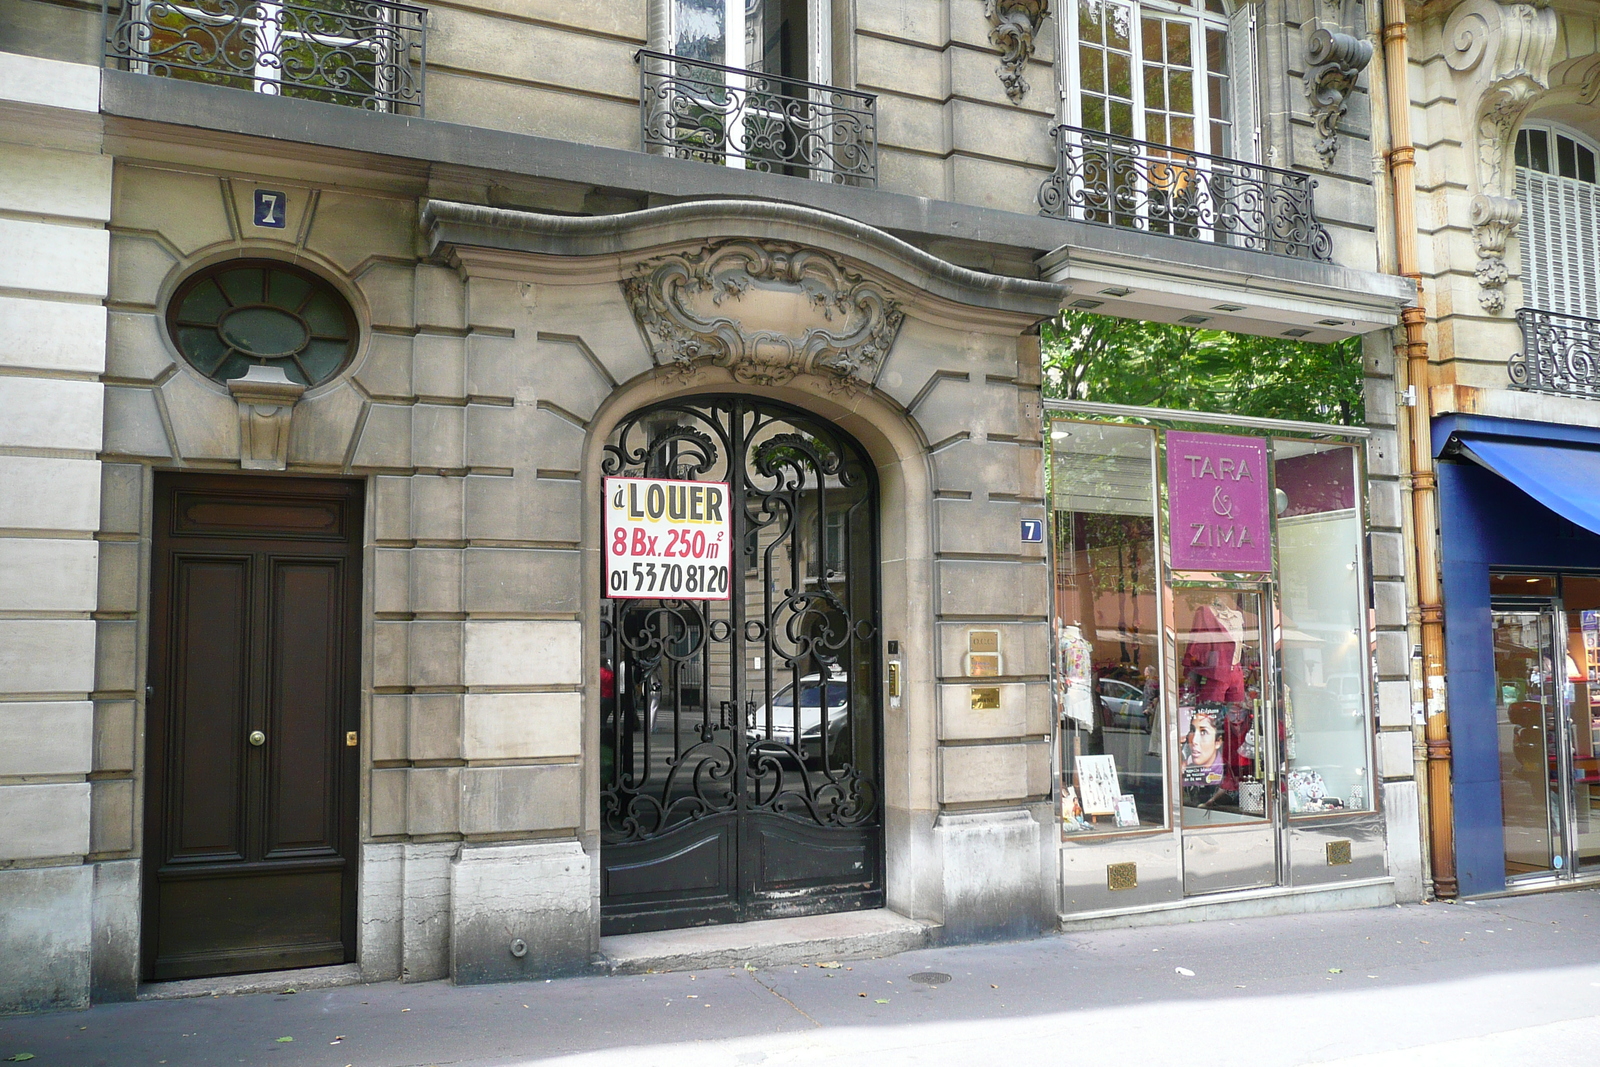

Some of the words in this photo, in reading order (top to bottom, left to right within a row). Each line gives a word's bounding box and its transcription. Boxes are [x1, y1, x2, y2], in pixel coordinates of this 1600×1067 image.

[262, 194, 277, 223] 7
[1184, 455, 1254, 482] TARA
[613, 484, 625, 510] à
[628, 483, 723, 524] LOUER
[1212, 485, 1234, 519] &
[612, 527, 627, 556] 8
[1024, 522, 1035, 540] 7
[1190, 523, 1255, 549] ZIMA
